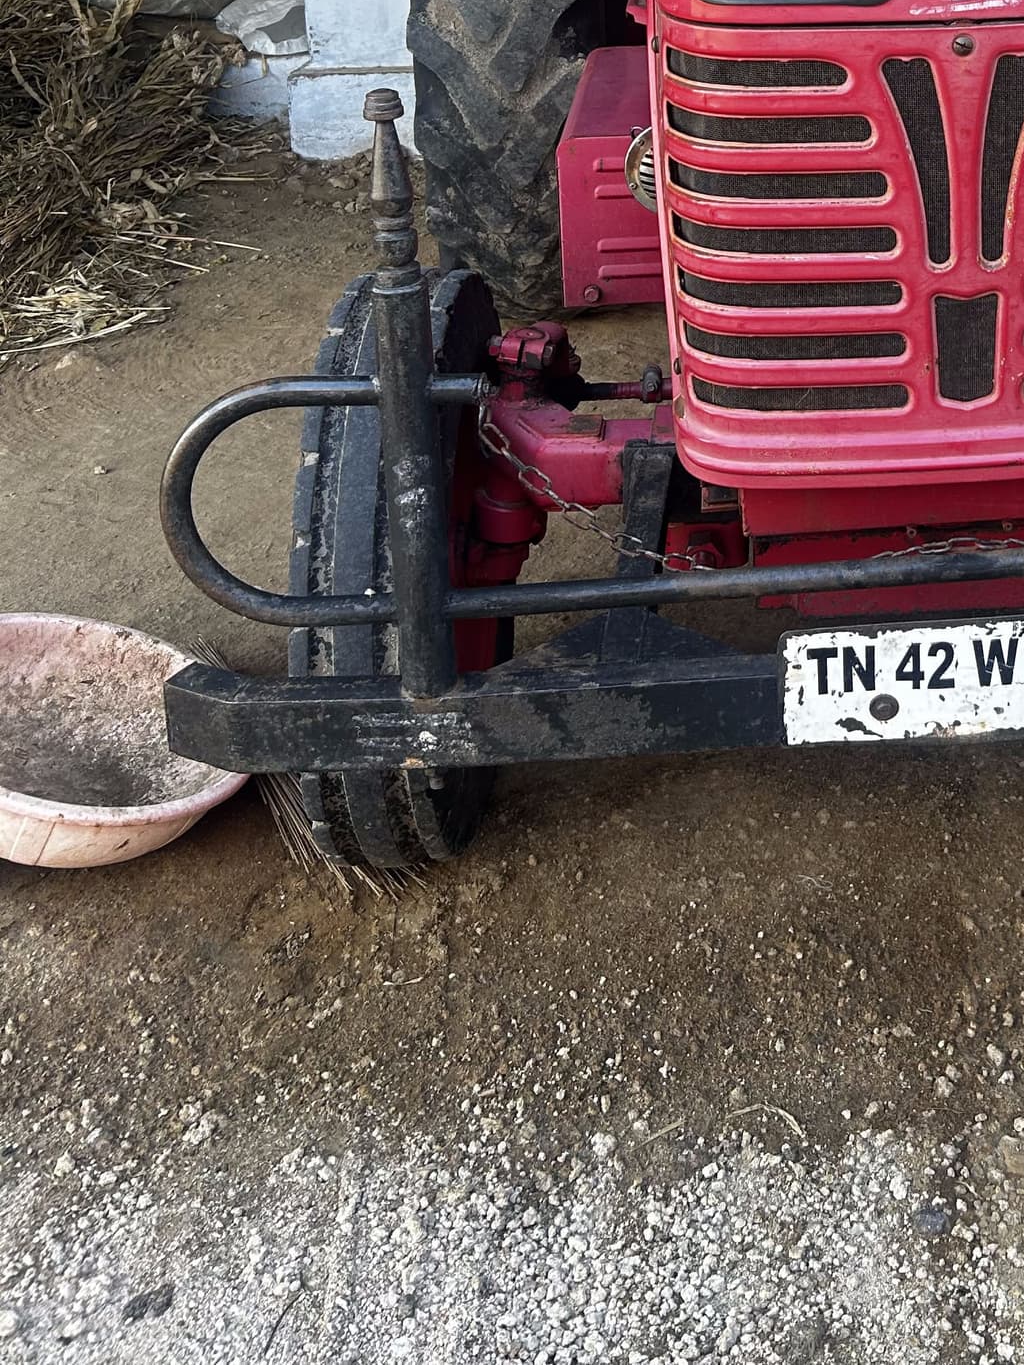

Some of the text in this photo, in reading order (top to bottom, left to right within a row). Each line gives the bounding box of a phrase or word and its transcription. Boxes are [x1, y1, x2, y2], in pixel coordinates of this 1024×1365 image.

[807, 645, 876, 695] TN
[895, 641, 957, 690] 42
[973, 637, 1019, 687] W
